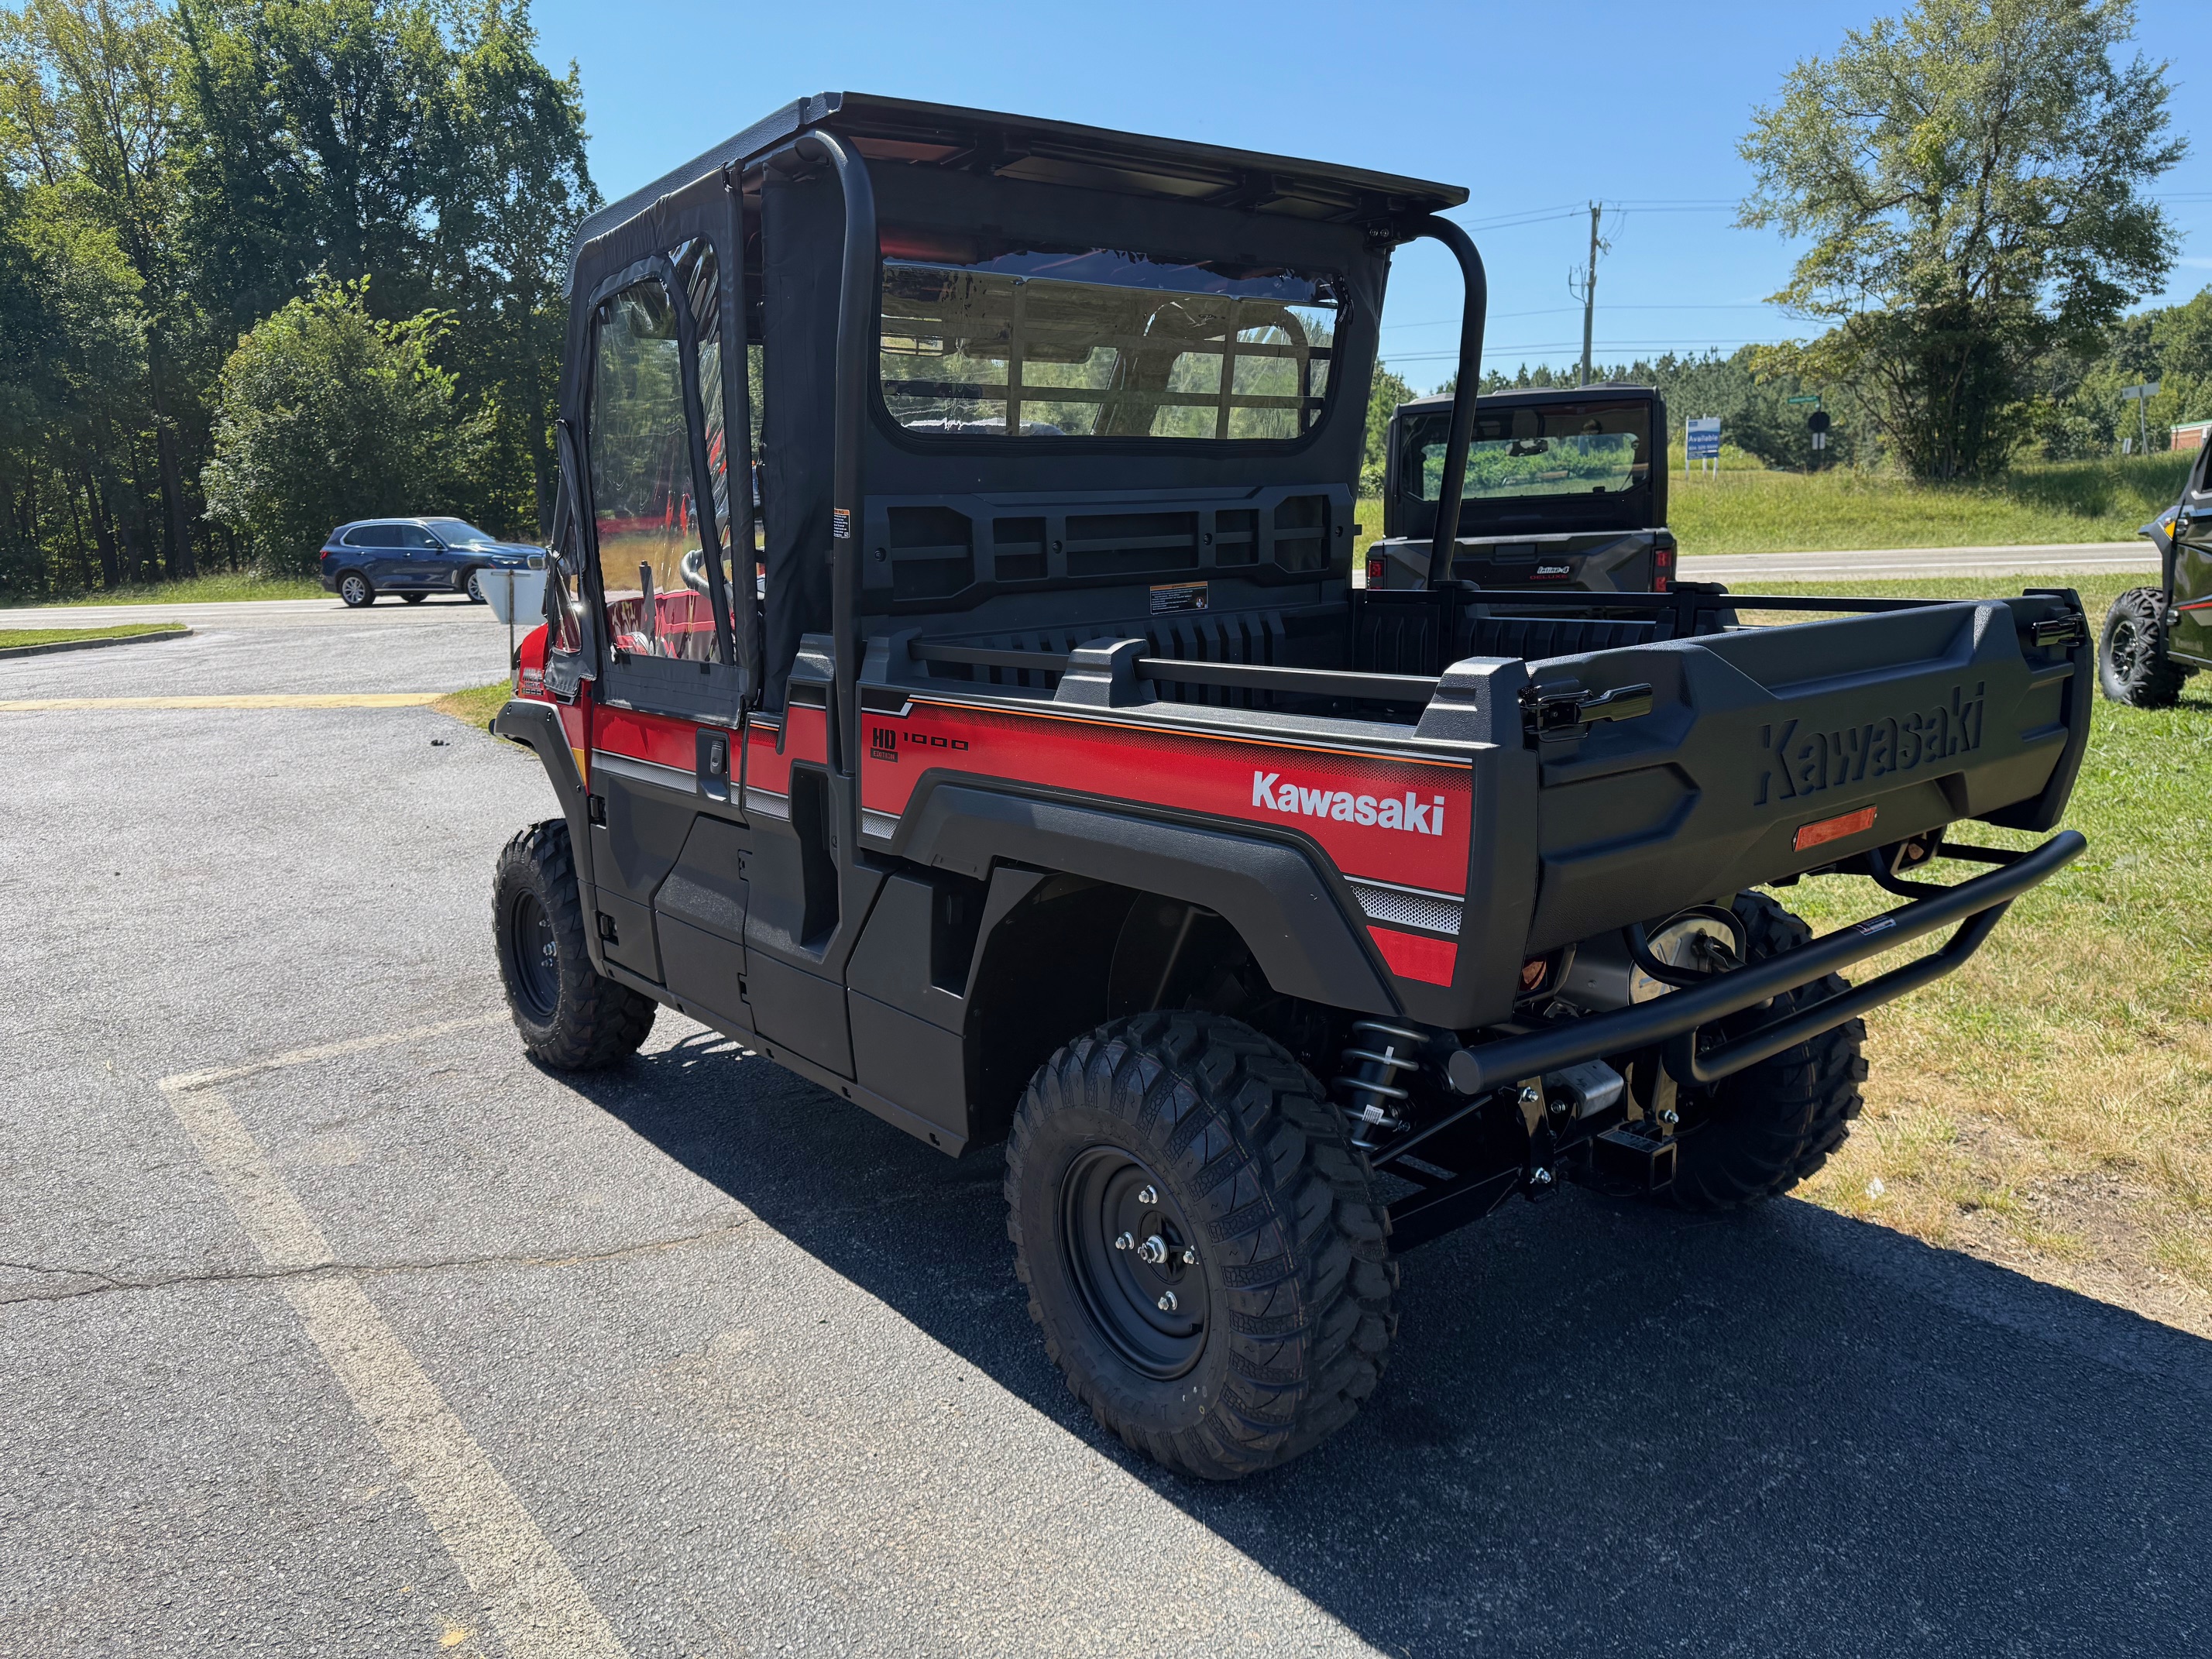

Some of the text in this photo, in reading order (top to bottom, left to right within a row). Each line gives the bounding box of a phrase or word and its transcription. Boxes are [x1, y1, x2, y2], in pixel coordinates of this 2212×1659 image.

[872, 727, 969, 751] HD 1000
[873, 750, 895, 760] EDITION
[1753, 680, 1985, 806] Kawasaki
[1252, 771, 1445, 836] Kawasaki
